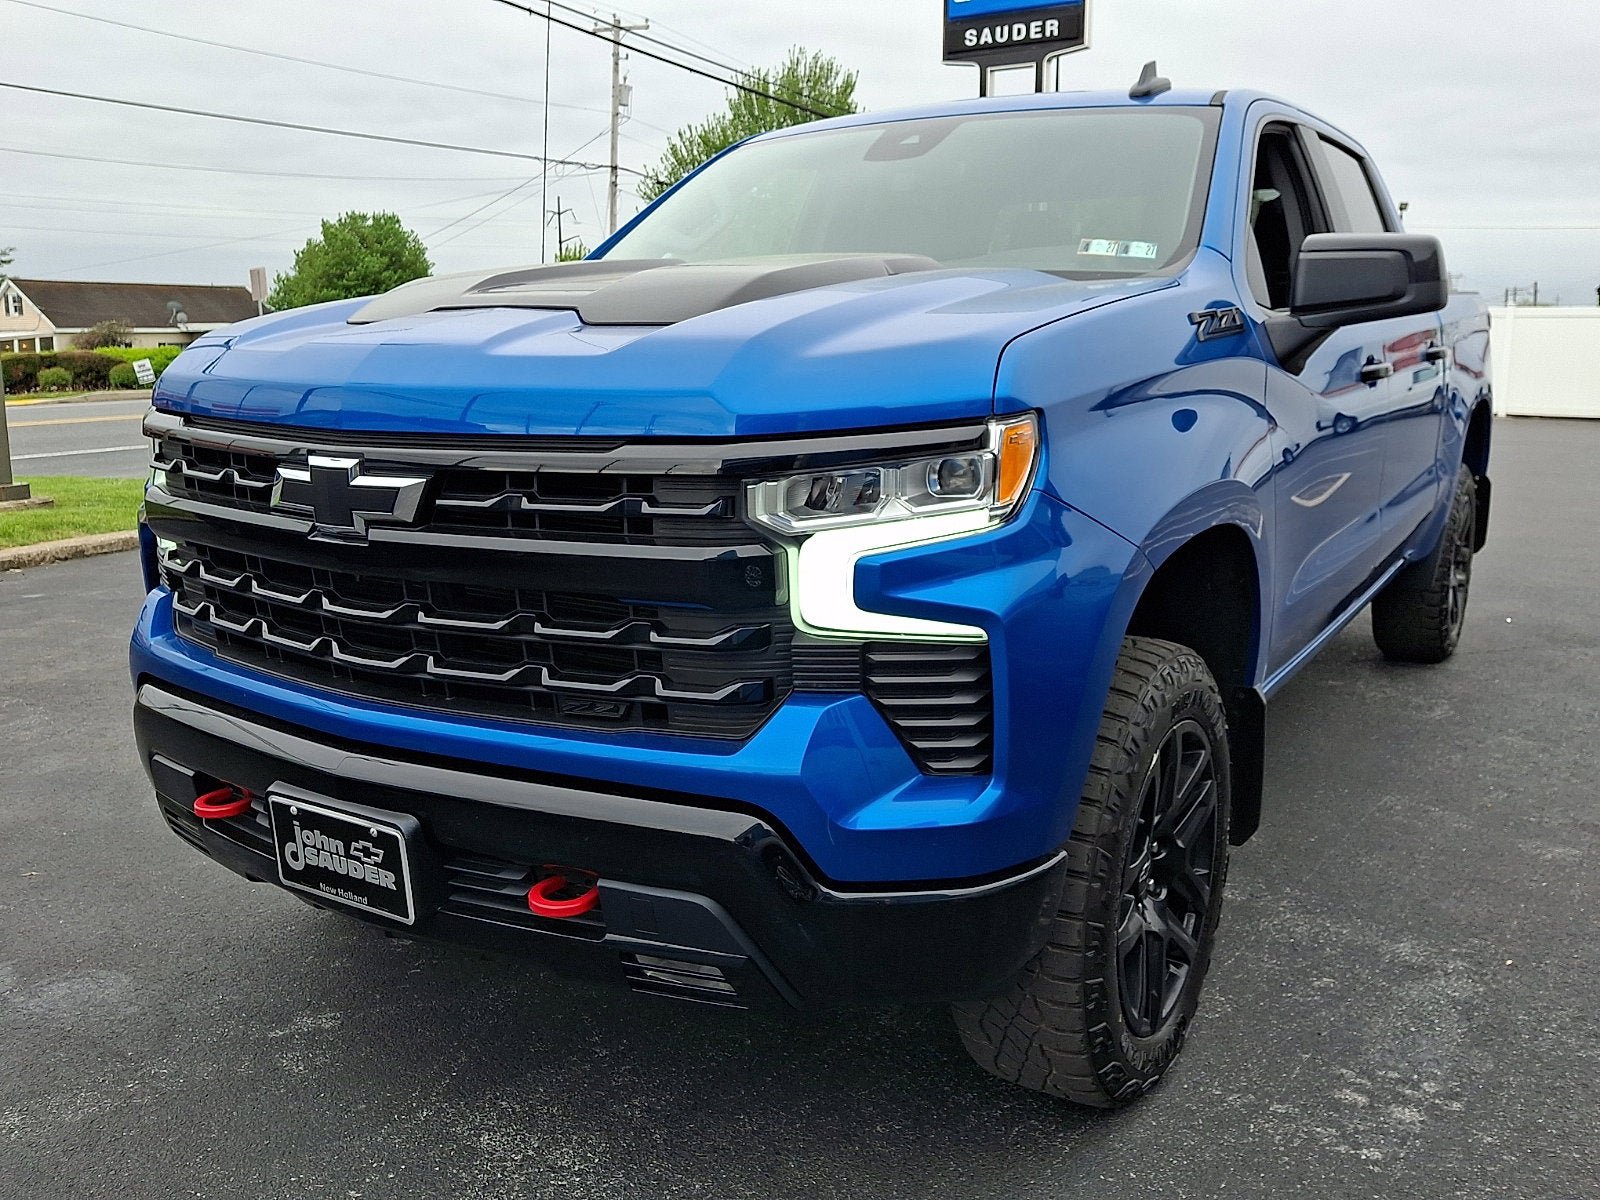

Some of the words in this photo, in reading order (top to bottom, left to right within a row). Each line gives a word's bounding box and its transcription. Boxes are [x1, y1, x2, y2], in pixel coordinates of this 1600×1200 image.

[964, 19, 1060, 47] SAUDER
[1187, 307, 1244, 342] Z71
[304, 847, 397, 890] SAUDER
[319, 882, 337, 895] New
[338, 887, 368, 905] Holland
